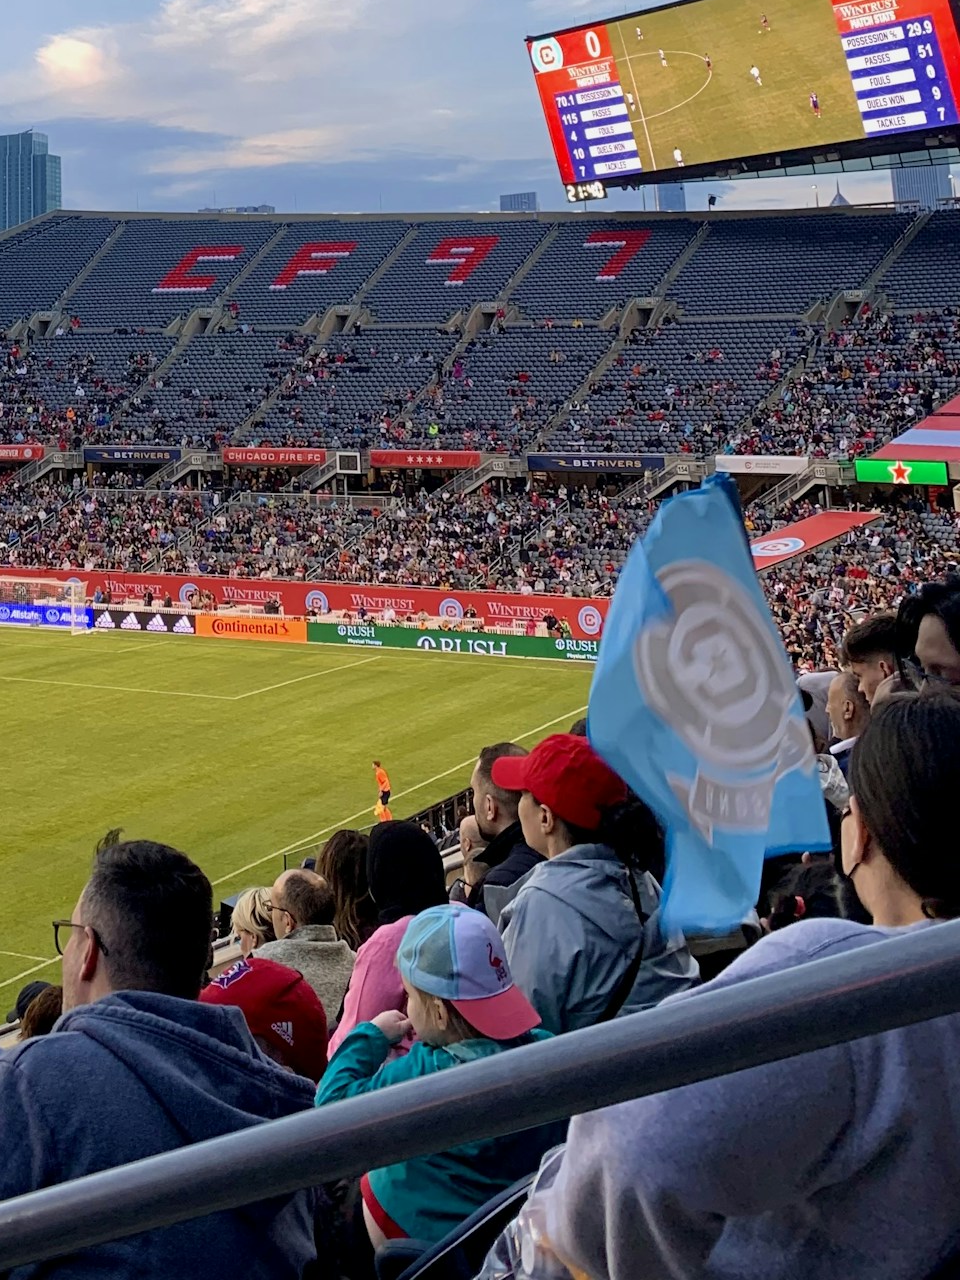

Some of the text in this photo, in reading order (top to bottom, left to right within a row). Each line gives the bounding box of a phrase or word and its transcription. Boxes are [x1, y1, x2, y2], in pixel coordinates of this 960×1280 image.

[906, 20, 933, 38] 29.9
[585, 31, 601, 58] 0
[846, 34, 888, 48] POSSESSION
[917, 43, 934, 58] 51
[864, 53, 891, 66] PASSES
[567, 61, 612, 78] WINTRUST
[869, 75, 891, 88] FOULS
[581, 90, 612, 102] POSSESSION
[932, 86, 942, 100] 9
[556, 94, 576, 109] 70.1
[866, 95, 906, 110] DUELS WON
[562, 112, 578, 126] 115
[592, 108, 612, 118] PASSES
[936, 107, 946, 121] 7
[876, 116, 906, 128] TACKLES
[570, 131, 578, 142] 4
[598, 125, 614, 136] FOULS
[573, 148, 585, 160] 10
[596, 145, 613, 155] DUELS
[579, 166, 586, 177] 7
[114, 452, 170, 460] BETRIVERS
[228, 452, 322, 462] CHICAGO FIRE FC
[572, 459, 642, 468] BETRIVERS
[222, 586, 282, 601] WINTRUST
[351, 594, 414, 610] WINTRUST
[10, 610, 39, 620] Allstate
[212, 619, 278, 635] Continental
[346, 626, 375, 637] RUSH
[441, 638, 507, 656] RUSH
[566, 640, 598, 652] RUSH
[271, 1023, 294, 1046] adidas
